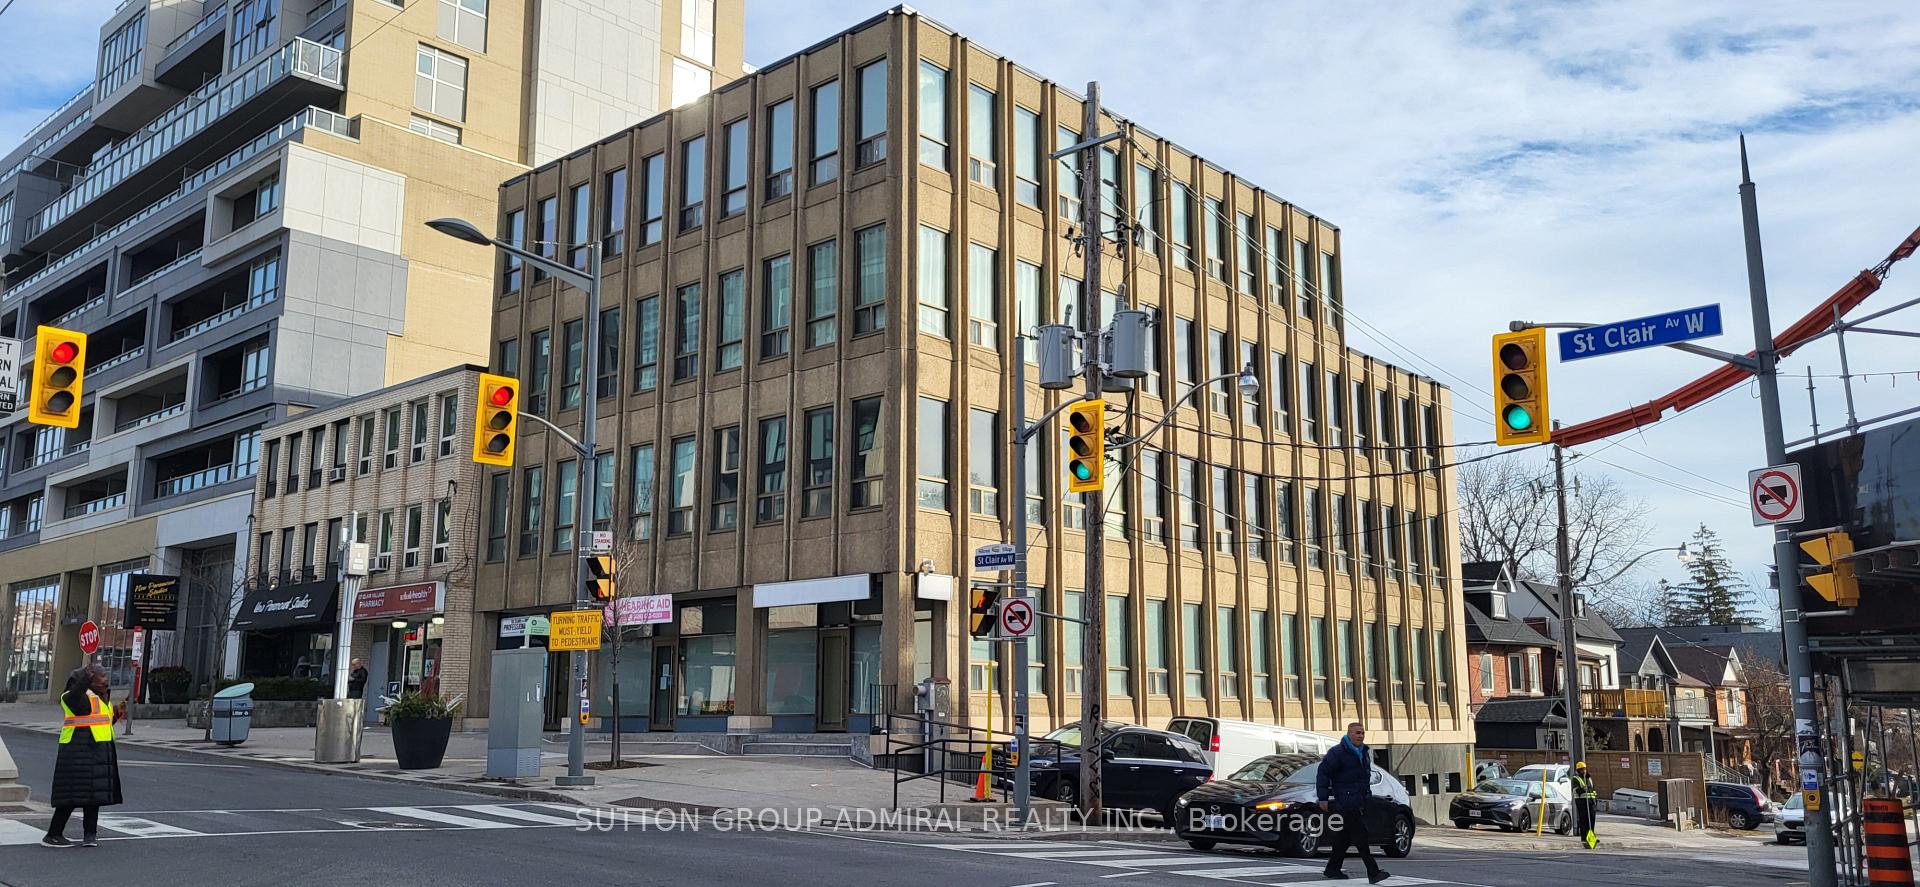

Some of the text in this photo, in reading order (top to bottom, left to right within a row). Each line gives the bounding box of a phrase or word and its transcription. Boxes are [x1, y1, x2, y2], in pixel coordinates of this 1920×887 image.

[1573, 311, 1704, 353] St Clair Av W
[977, 557, 984, 565] St
[985, 555, 1000, 564] Clair
[1007, 554, 1014, 562] W
[359, 599, 385, 608] PHARMACY
[656, 598, 671, 609] AID
[553, 614, 600, 625] TURNING TRAFFIC
[576, 626, 592, 634] YIELD
[80, 629, 98, 647] STOP
[551, 636, 599, 647] TO PEDESTRIANS
